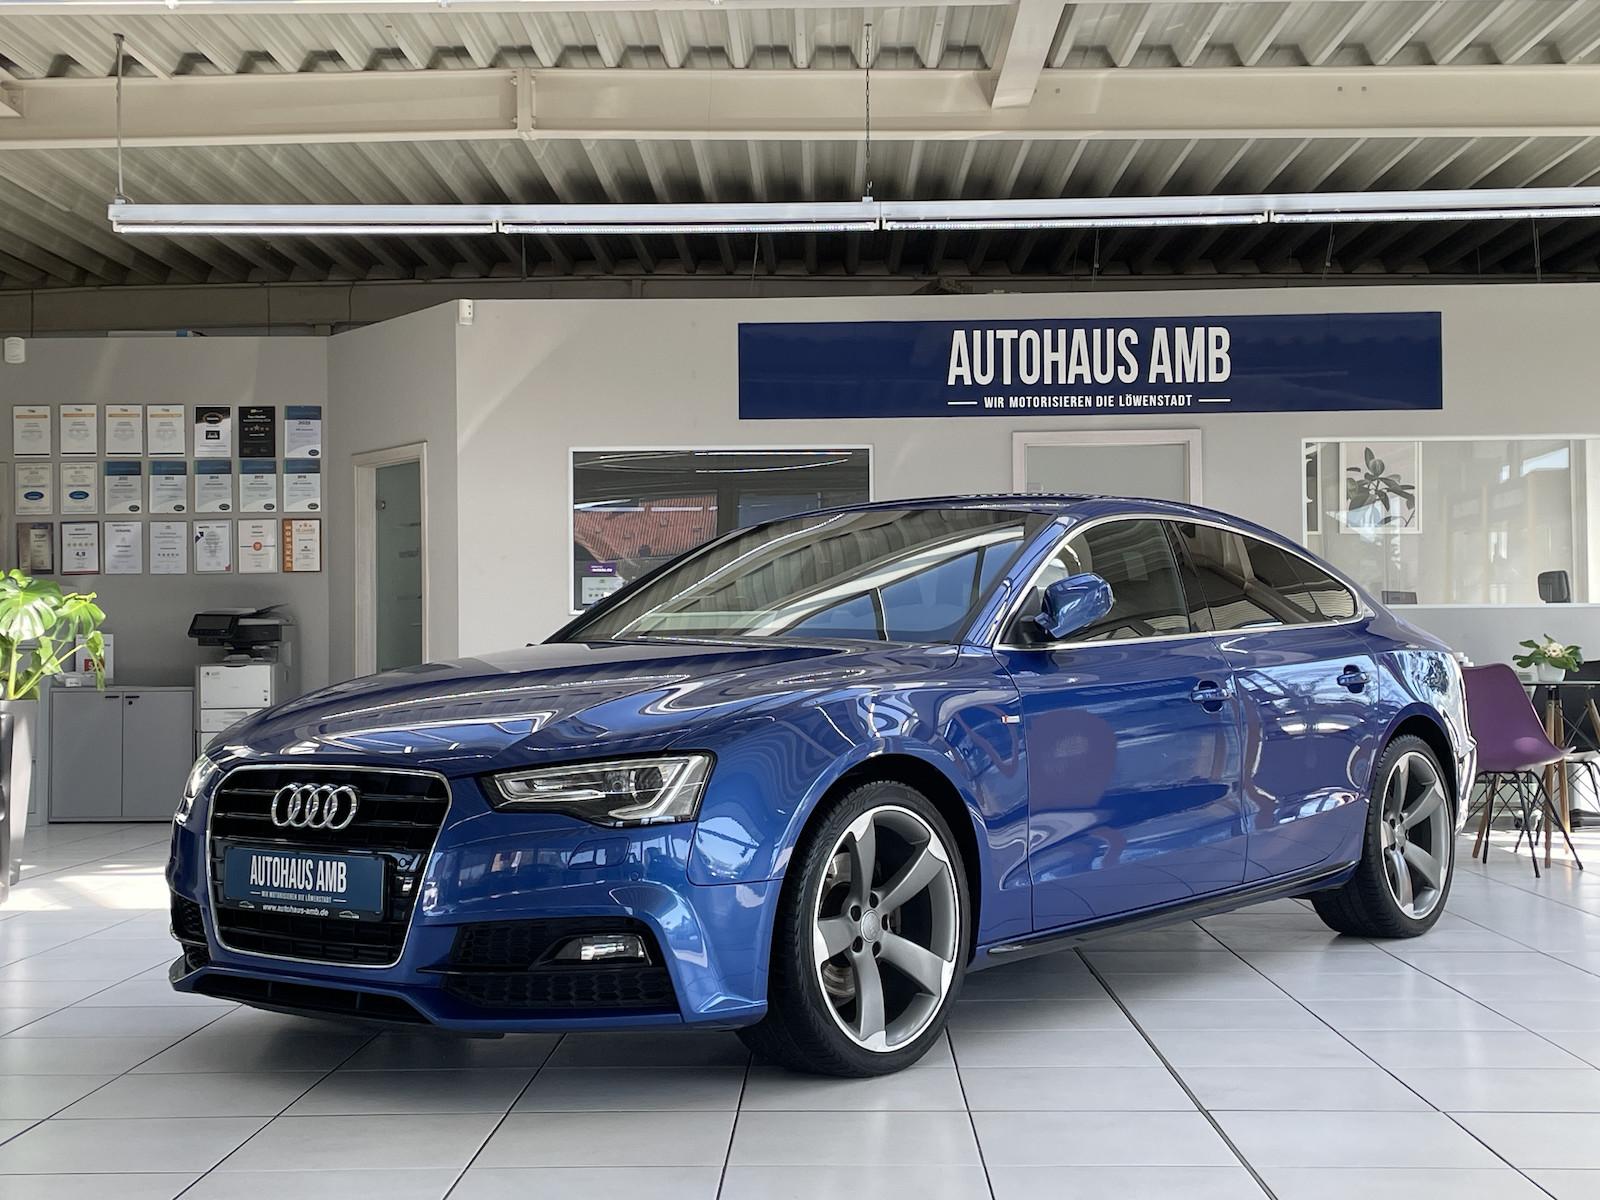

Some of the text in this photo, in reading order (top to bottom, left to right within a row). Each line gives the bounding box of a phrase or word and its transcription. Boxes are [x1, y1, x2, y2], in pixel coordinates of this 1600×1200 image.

[948, 326, 1231, 386] AUTOHAUS AMB
[983, 393, 1193, 409] WIR MOTORISIEREN DIE LÖWENSTADT
[250, 855, 347, 893] AUTOHAUS AMB
[262, 904, 329, 917] www.autohaus-amb.de
